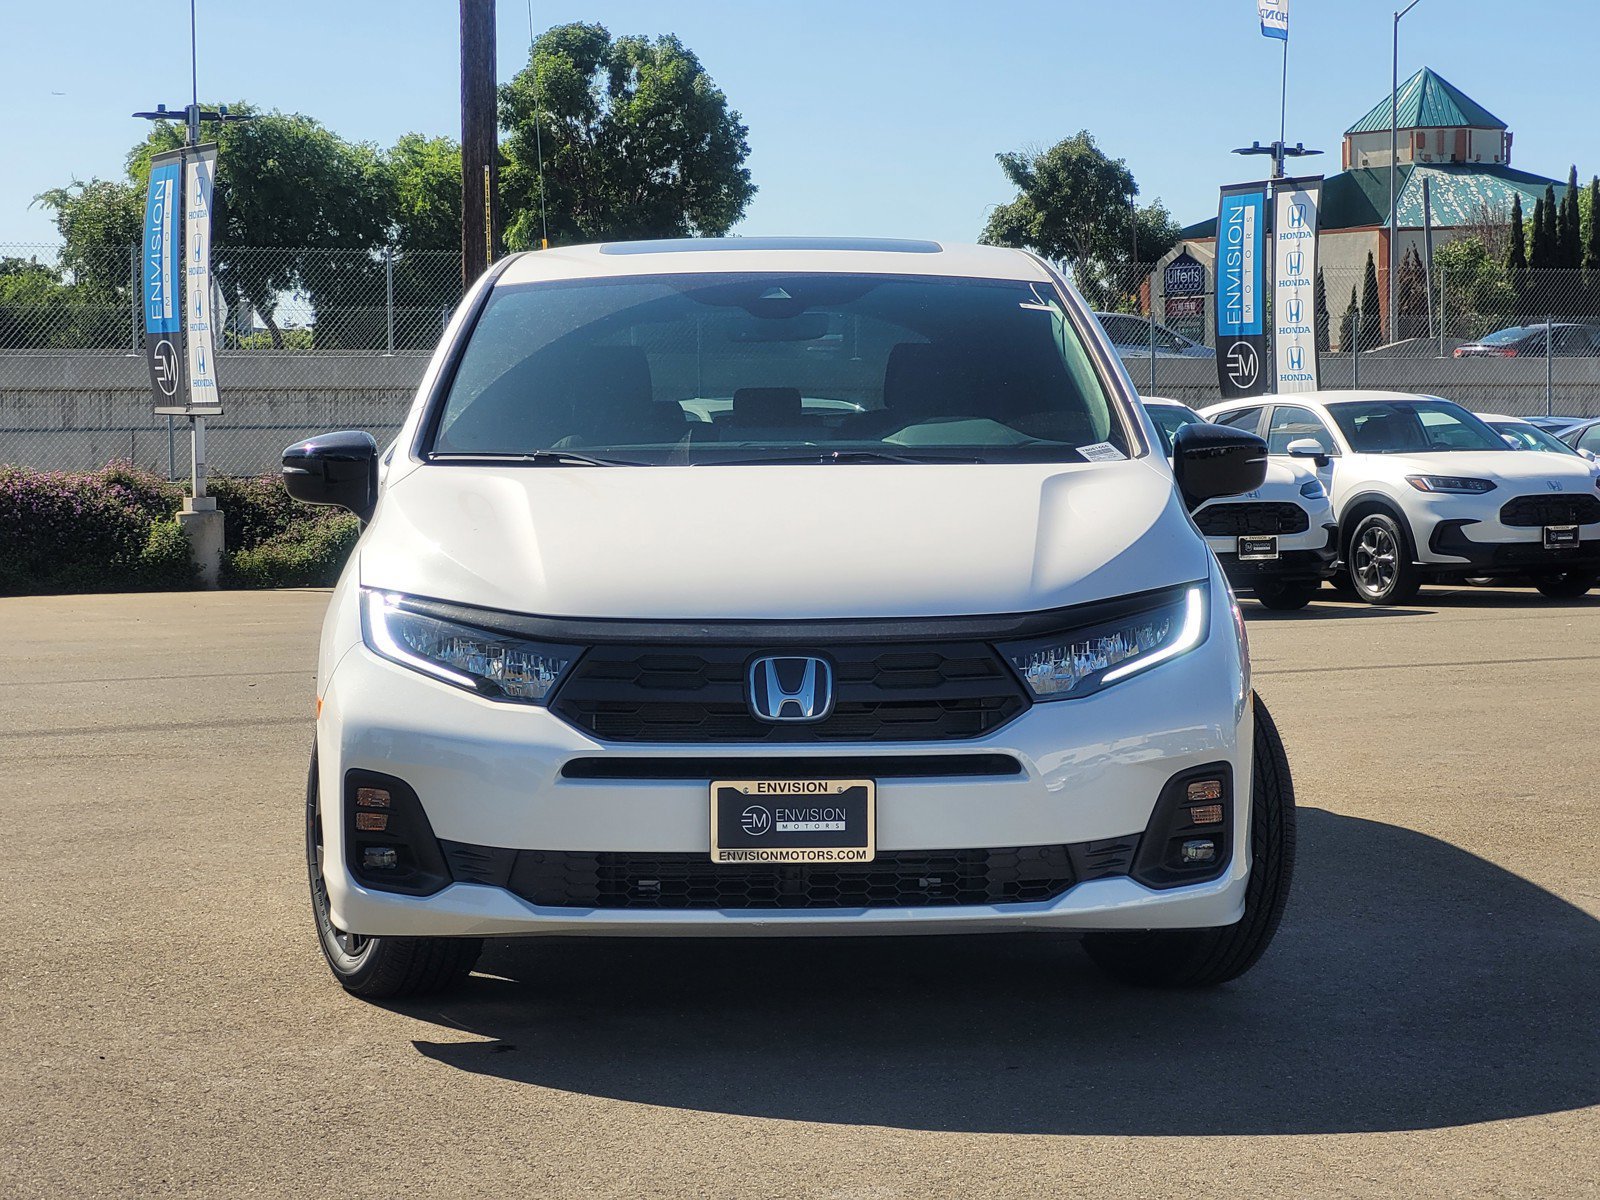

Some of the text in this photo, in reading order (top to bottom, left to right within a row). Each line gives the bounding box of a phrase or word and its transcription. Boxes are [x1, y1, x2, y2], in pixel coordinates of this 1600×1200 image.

[188, 210, 207, 219] HONDA
[1279, 231, 1312, 240] HONDA
[151, 180, 165, 319] ENVISION
[1226, 205, 1244, 324] ENVISION
[1245, 216, 1253, 313] MOTORS
[188, 266, 206, 275] HONDA
[1278, 278, 1311, 287] HONDA
[189, 322, 209, 332] HONDA
[1278, 325, 1311, 334] HONDA
[1280, 373, 1313, 382] HONDA
[192, 378, 214, 388] HONDA
[757, 782, 828, 793] ENVISION
[776, 808, 845, 821] ENVISION
[719, 850, 867, 861] ENVISIONMOTORS.COM
